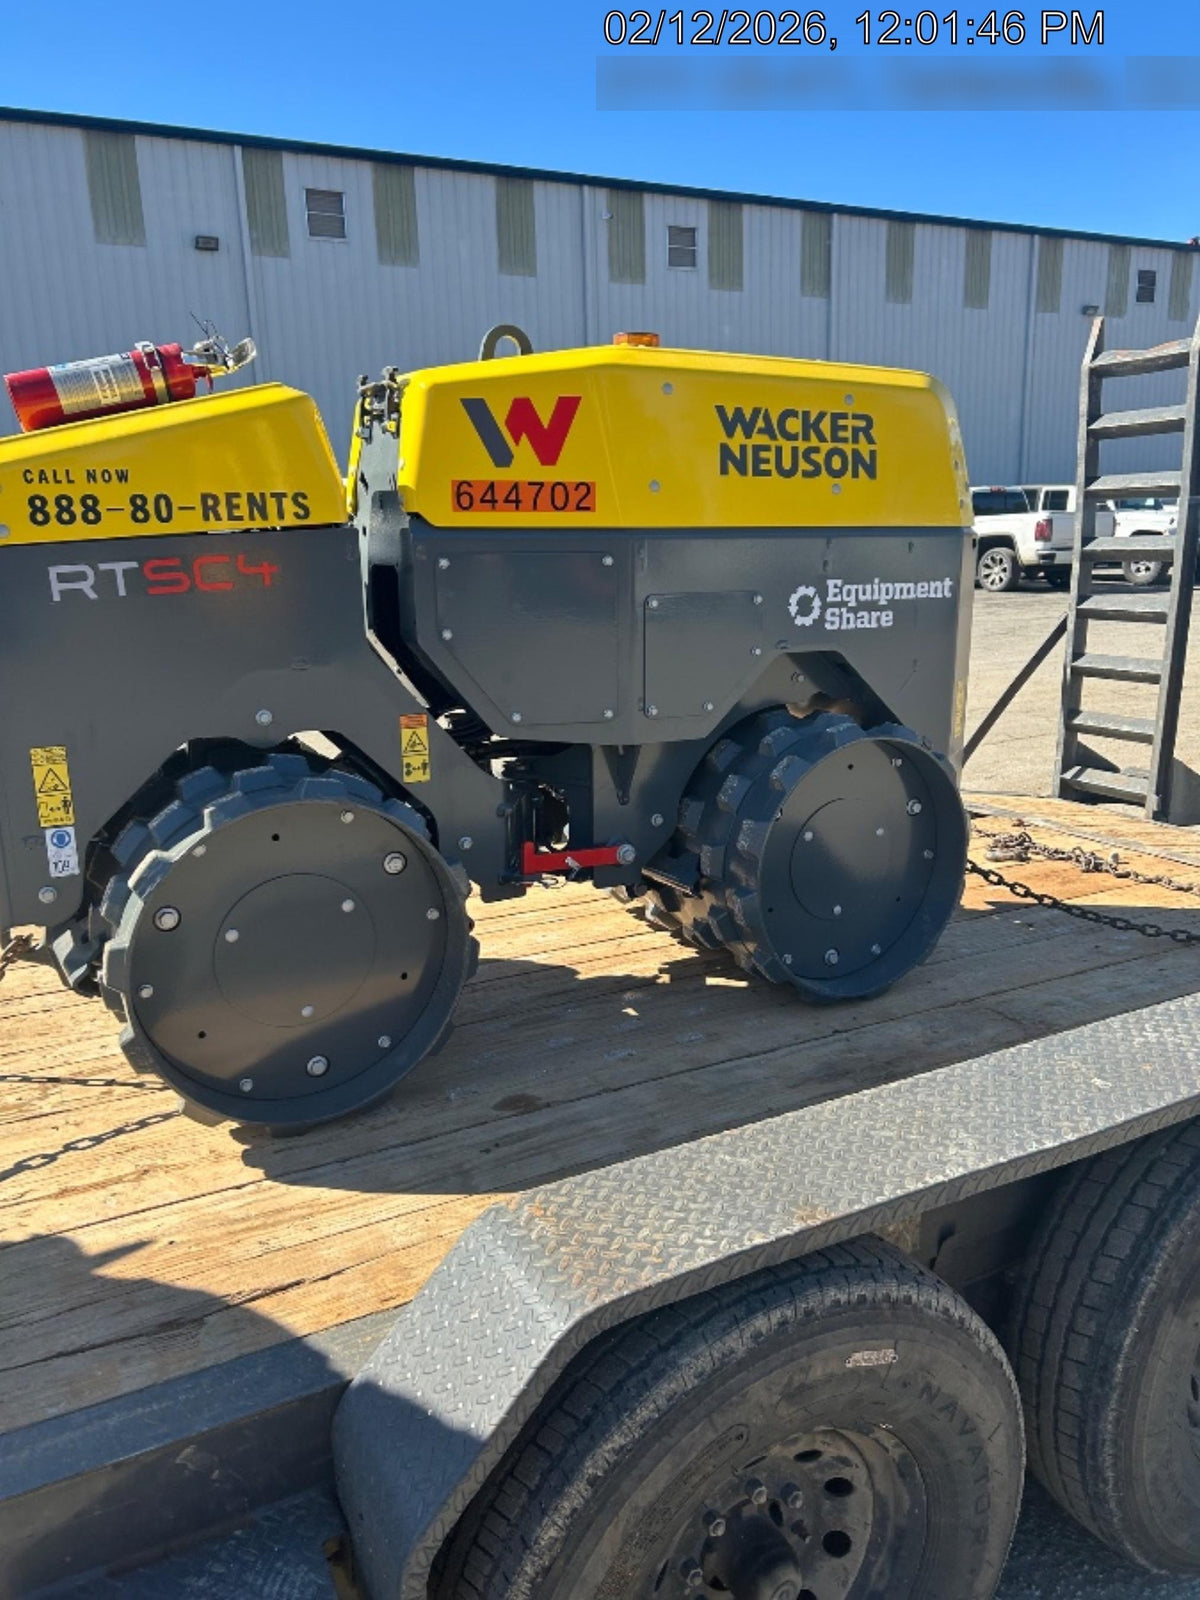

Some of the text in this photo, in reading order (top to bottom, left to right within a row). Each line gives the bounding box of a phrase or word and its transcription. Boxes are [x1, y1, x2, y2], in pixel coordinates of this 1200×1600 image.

[714, 405, 876, 444] WACKER
[23, 468, 129, 484] CALL NOW
[719, 443, 877, 480] NEUSON
[455, 481, 592, 511] 644702
[48, 554, 279, 601] RTSC4
[826, 577, 953, 606] Equipment
[824, 608, 893, 630] Share
